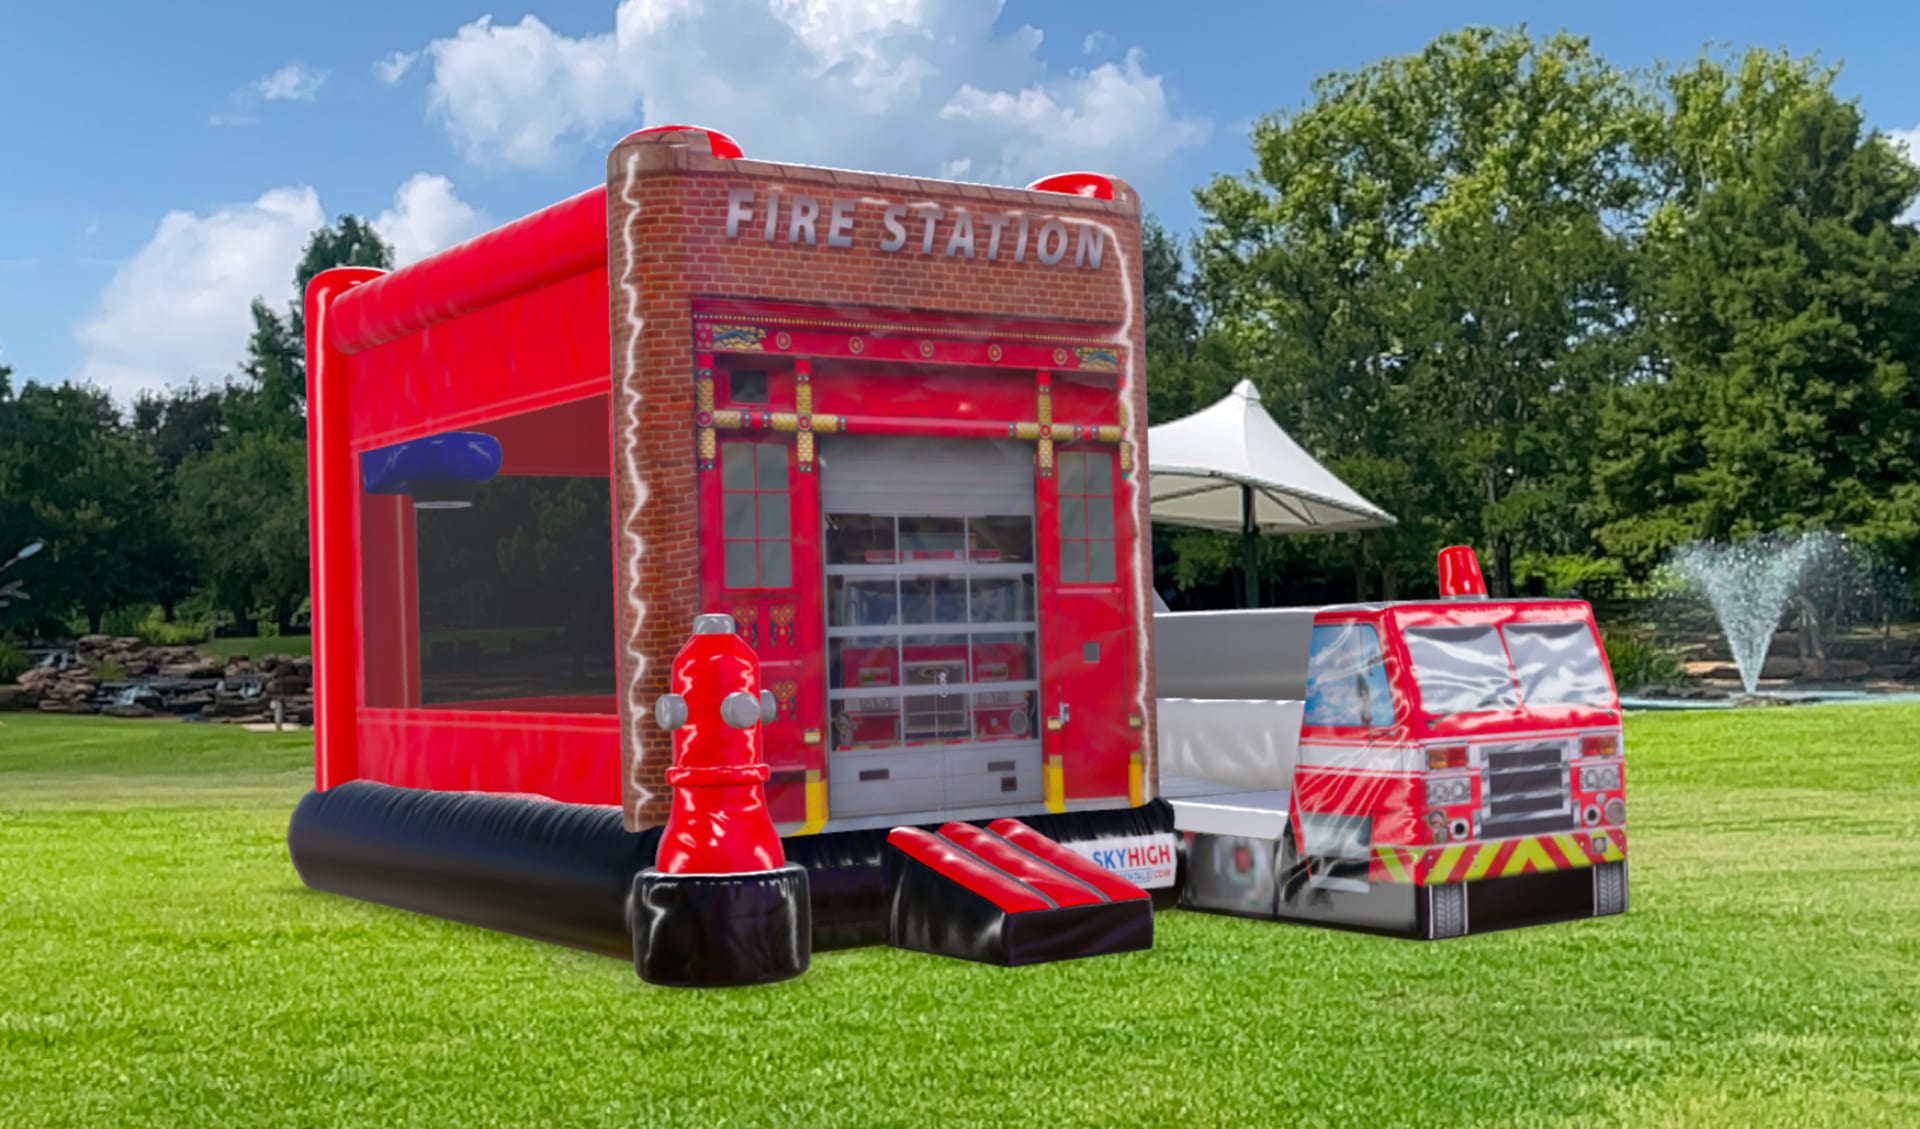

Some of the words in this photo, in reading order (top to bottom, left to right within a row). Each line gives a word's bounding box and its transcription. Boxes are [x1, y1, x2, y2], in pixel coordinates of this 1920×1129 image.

[726, 190, 856, 248] FIRE
[880, 205, 1105, 269] STATION
[1092, 844, 1171, 869] SKYHIGH
